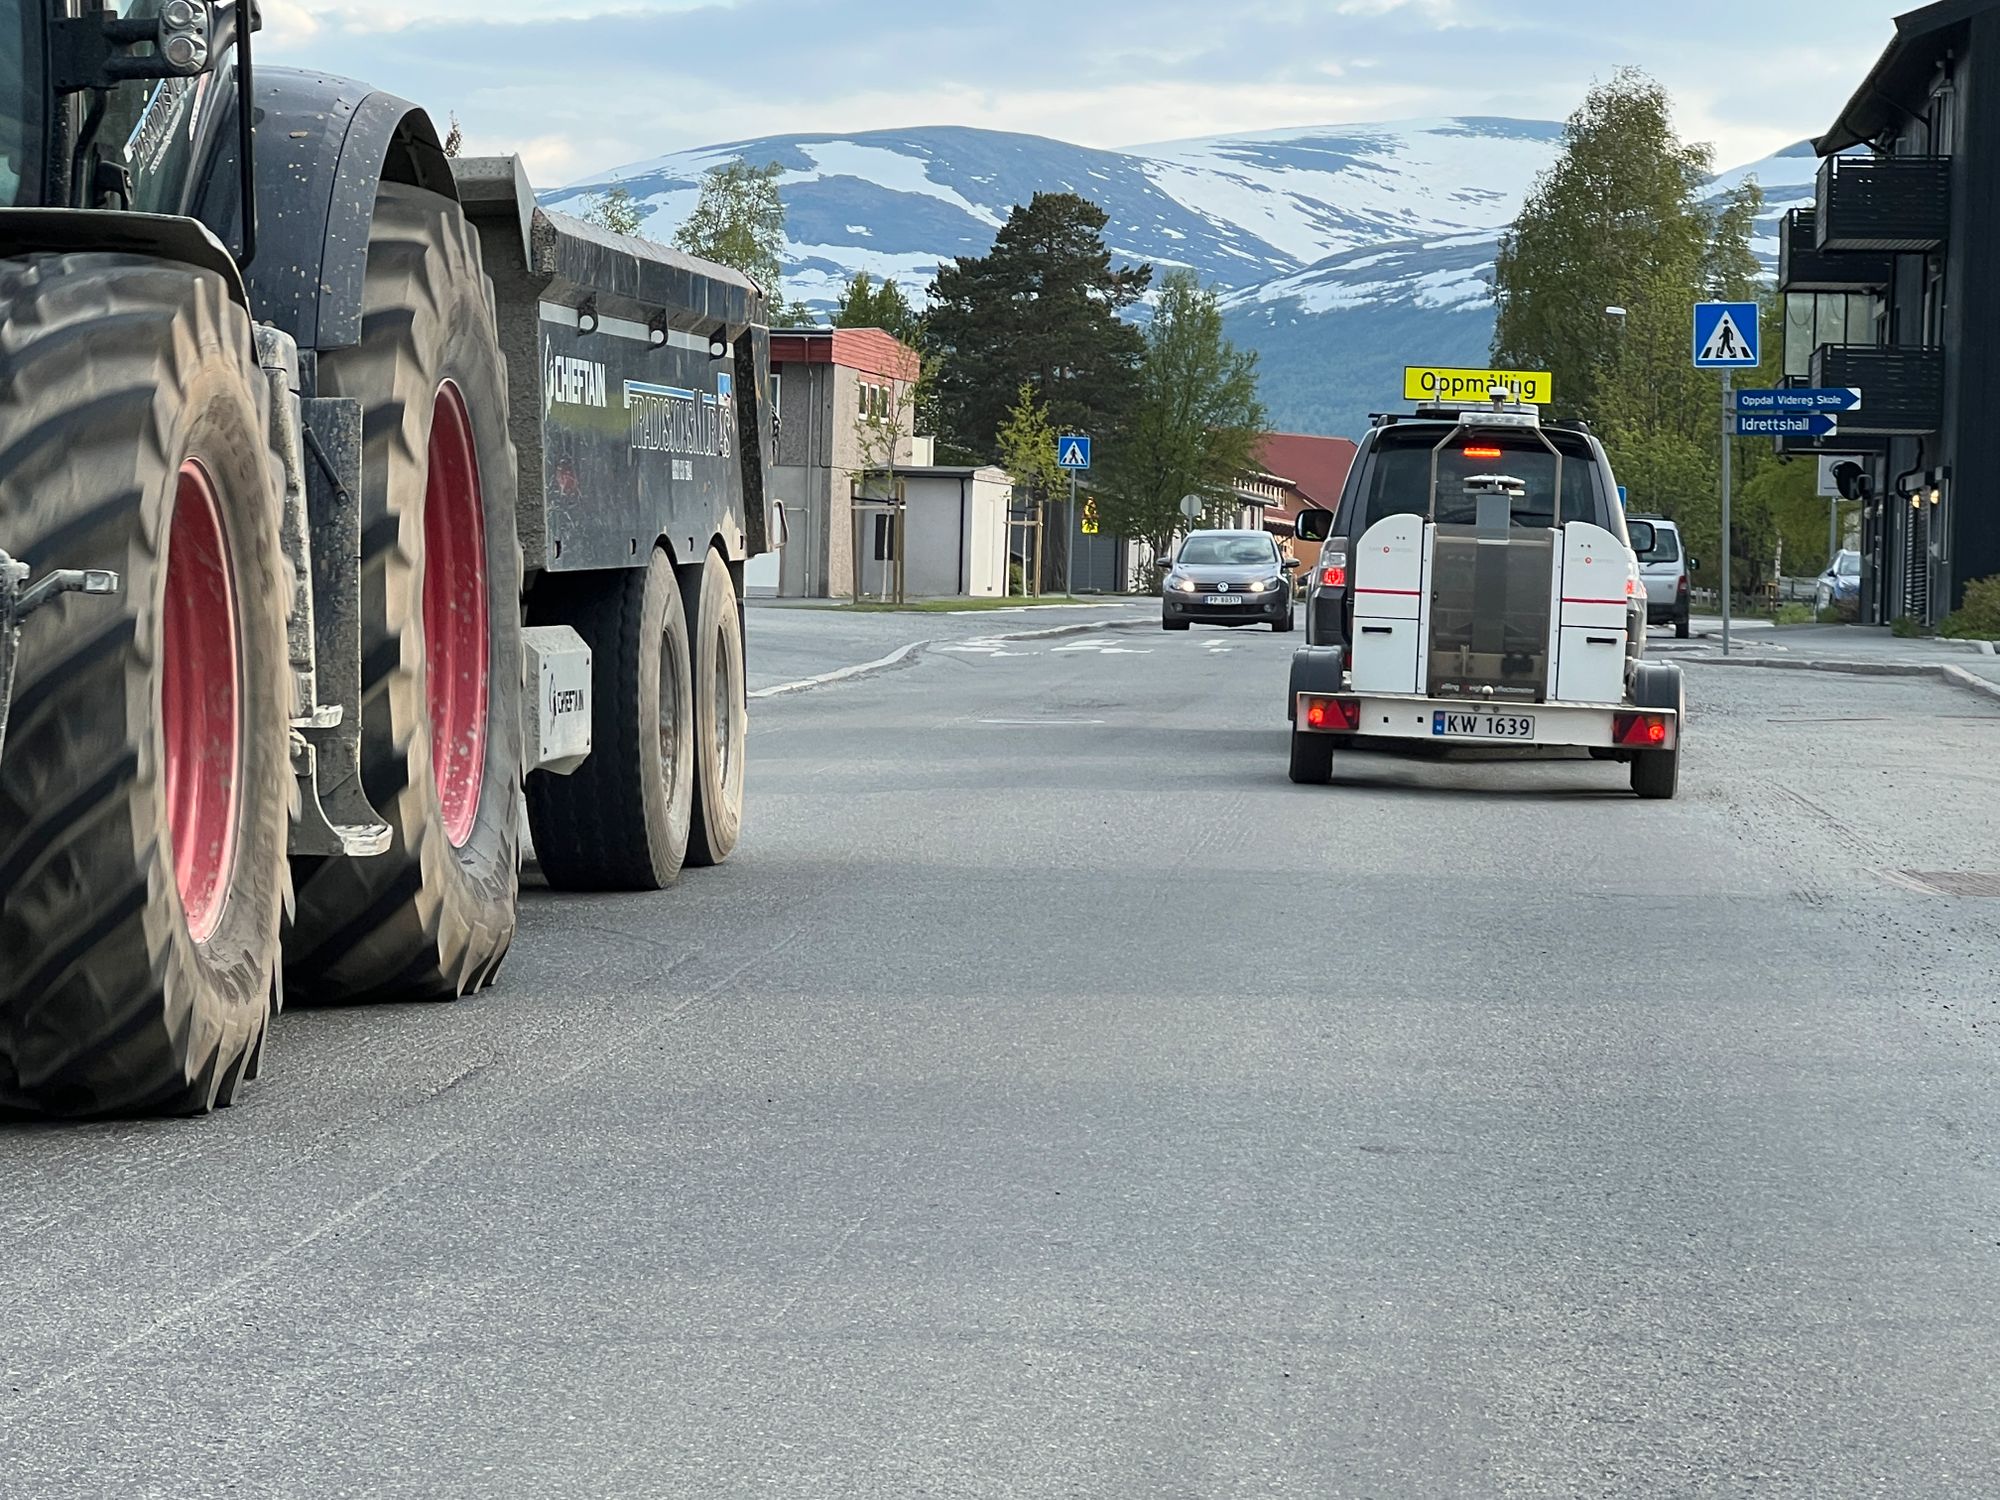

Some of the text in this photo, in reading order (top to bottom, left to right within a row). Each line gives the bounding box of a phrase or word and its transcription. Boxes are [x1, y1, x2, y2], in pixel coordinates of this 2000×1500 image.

[554, 355, 607, 408] CHIEFTAIN
[1420, 371, 1536, 399] Oppmåling
[1741, 396, 1774, 406] Oppdal
[1816, 395, 1842, 405] Skole
[1741, 417, 1809, 431] Idrettshall
[557, 689, 584, 713] CHIEFTAIN
[1447, 715, 1530, 736] KW 1639
